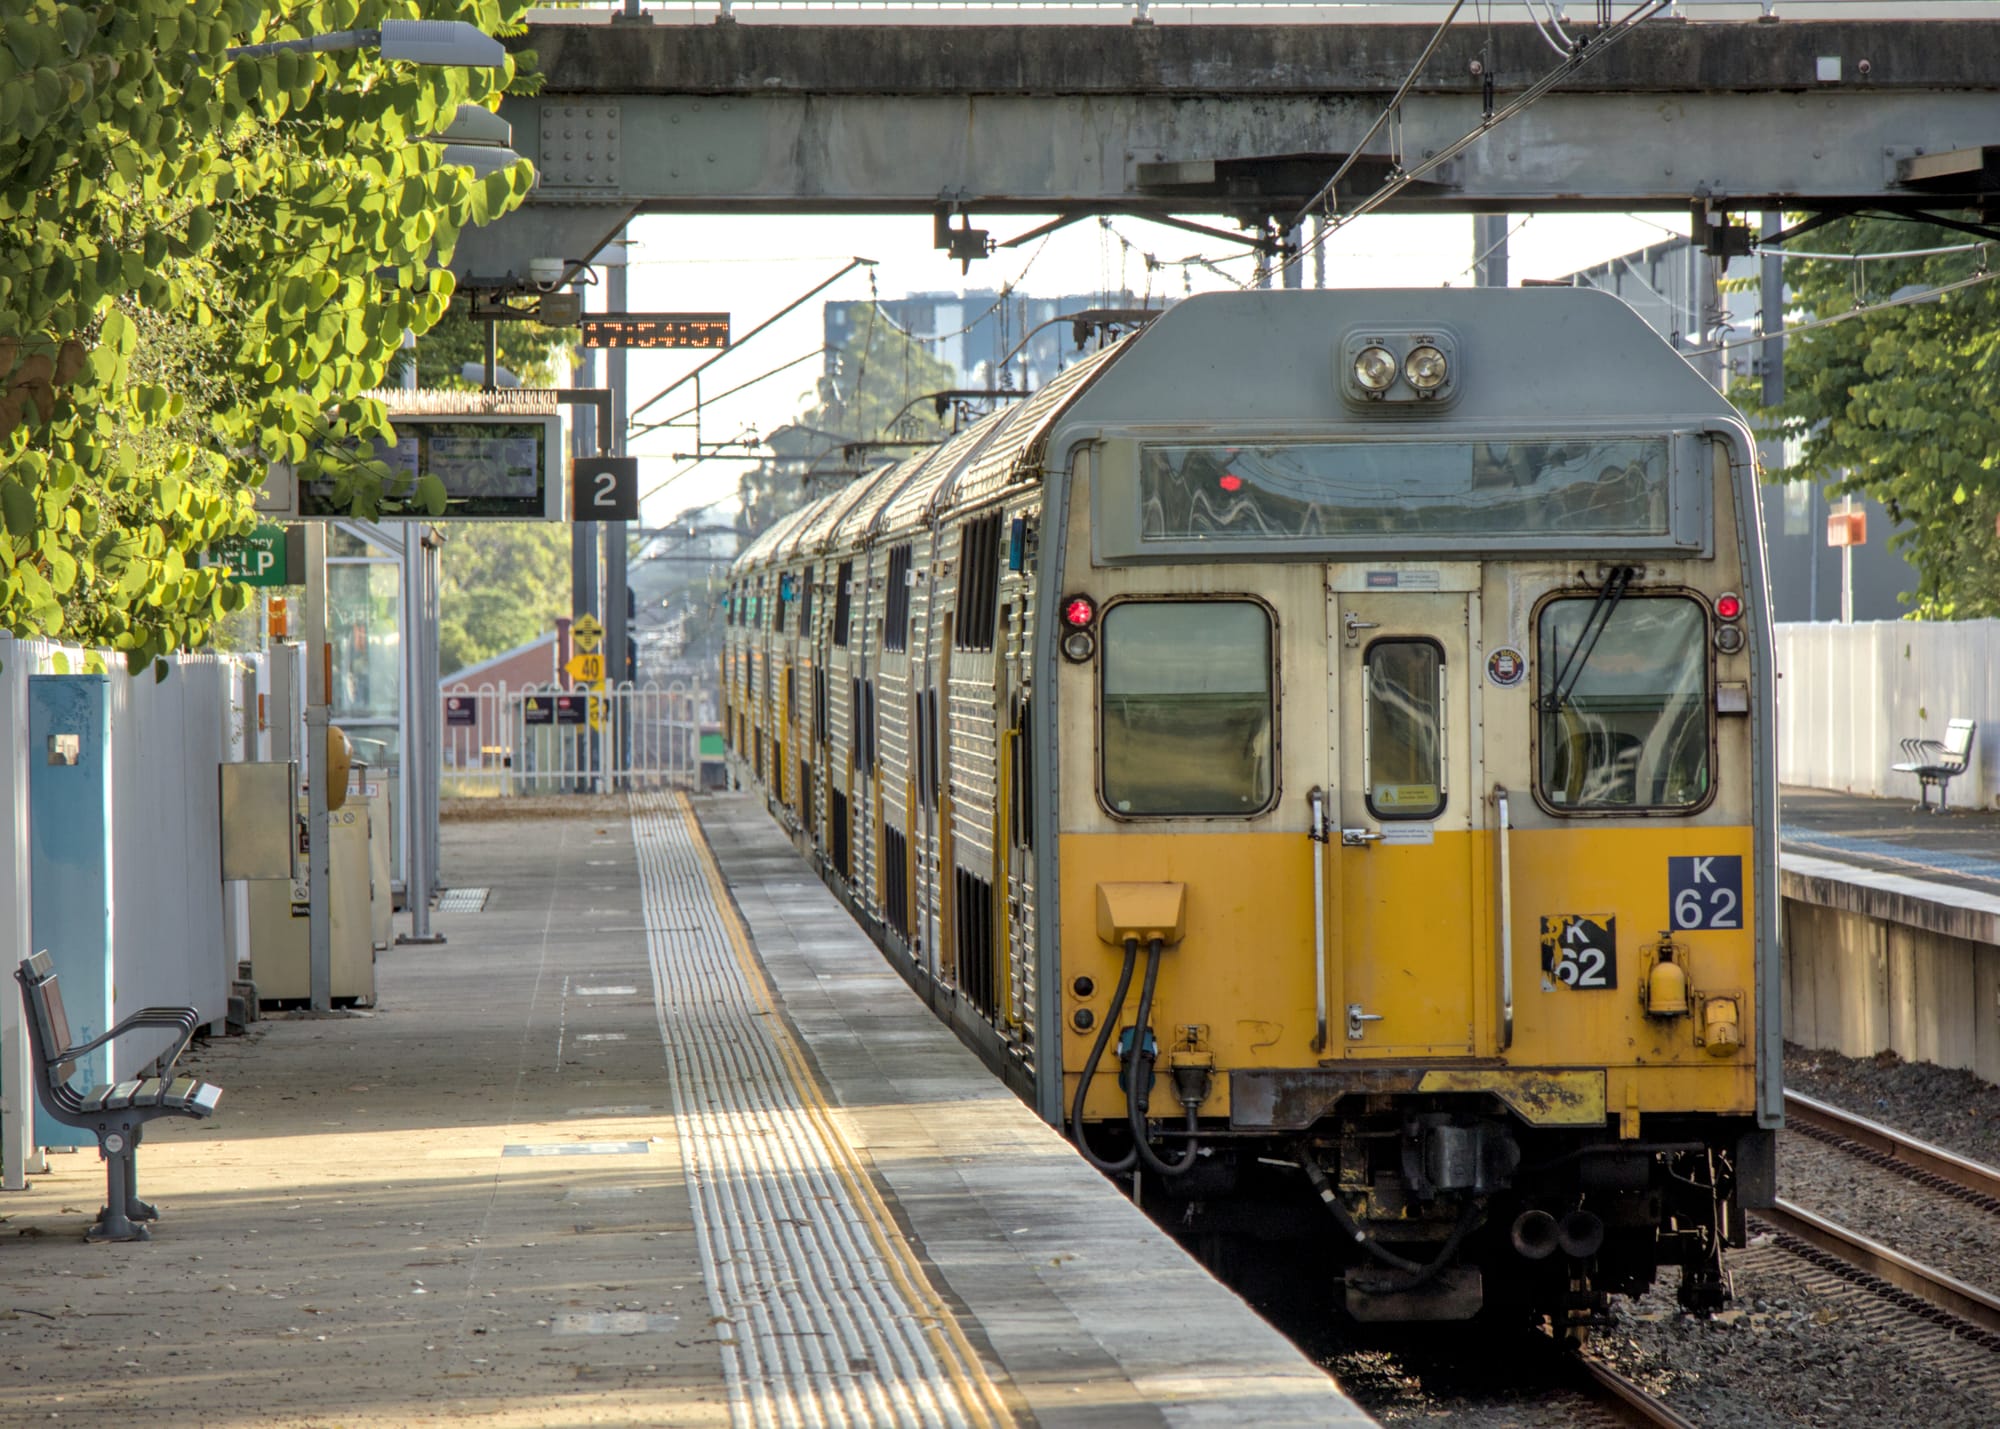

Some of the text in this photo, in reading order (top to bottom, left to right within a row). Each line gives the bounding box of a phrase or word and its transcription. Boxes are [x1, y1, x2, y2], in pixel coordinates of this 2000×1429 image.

[586, 322, 729, 347] 17:54:37
[593, 472, 617, 506] 2
[581, 656, 599, 679] 40
[1692, 856, 1717, 883] K
[1674, 887, 1737, 929] 62
[1566, 919, 1591, 944] K
[1552, 947, 1607, 987] 62
